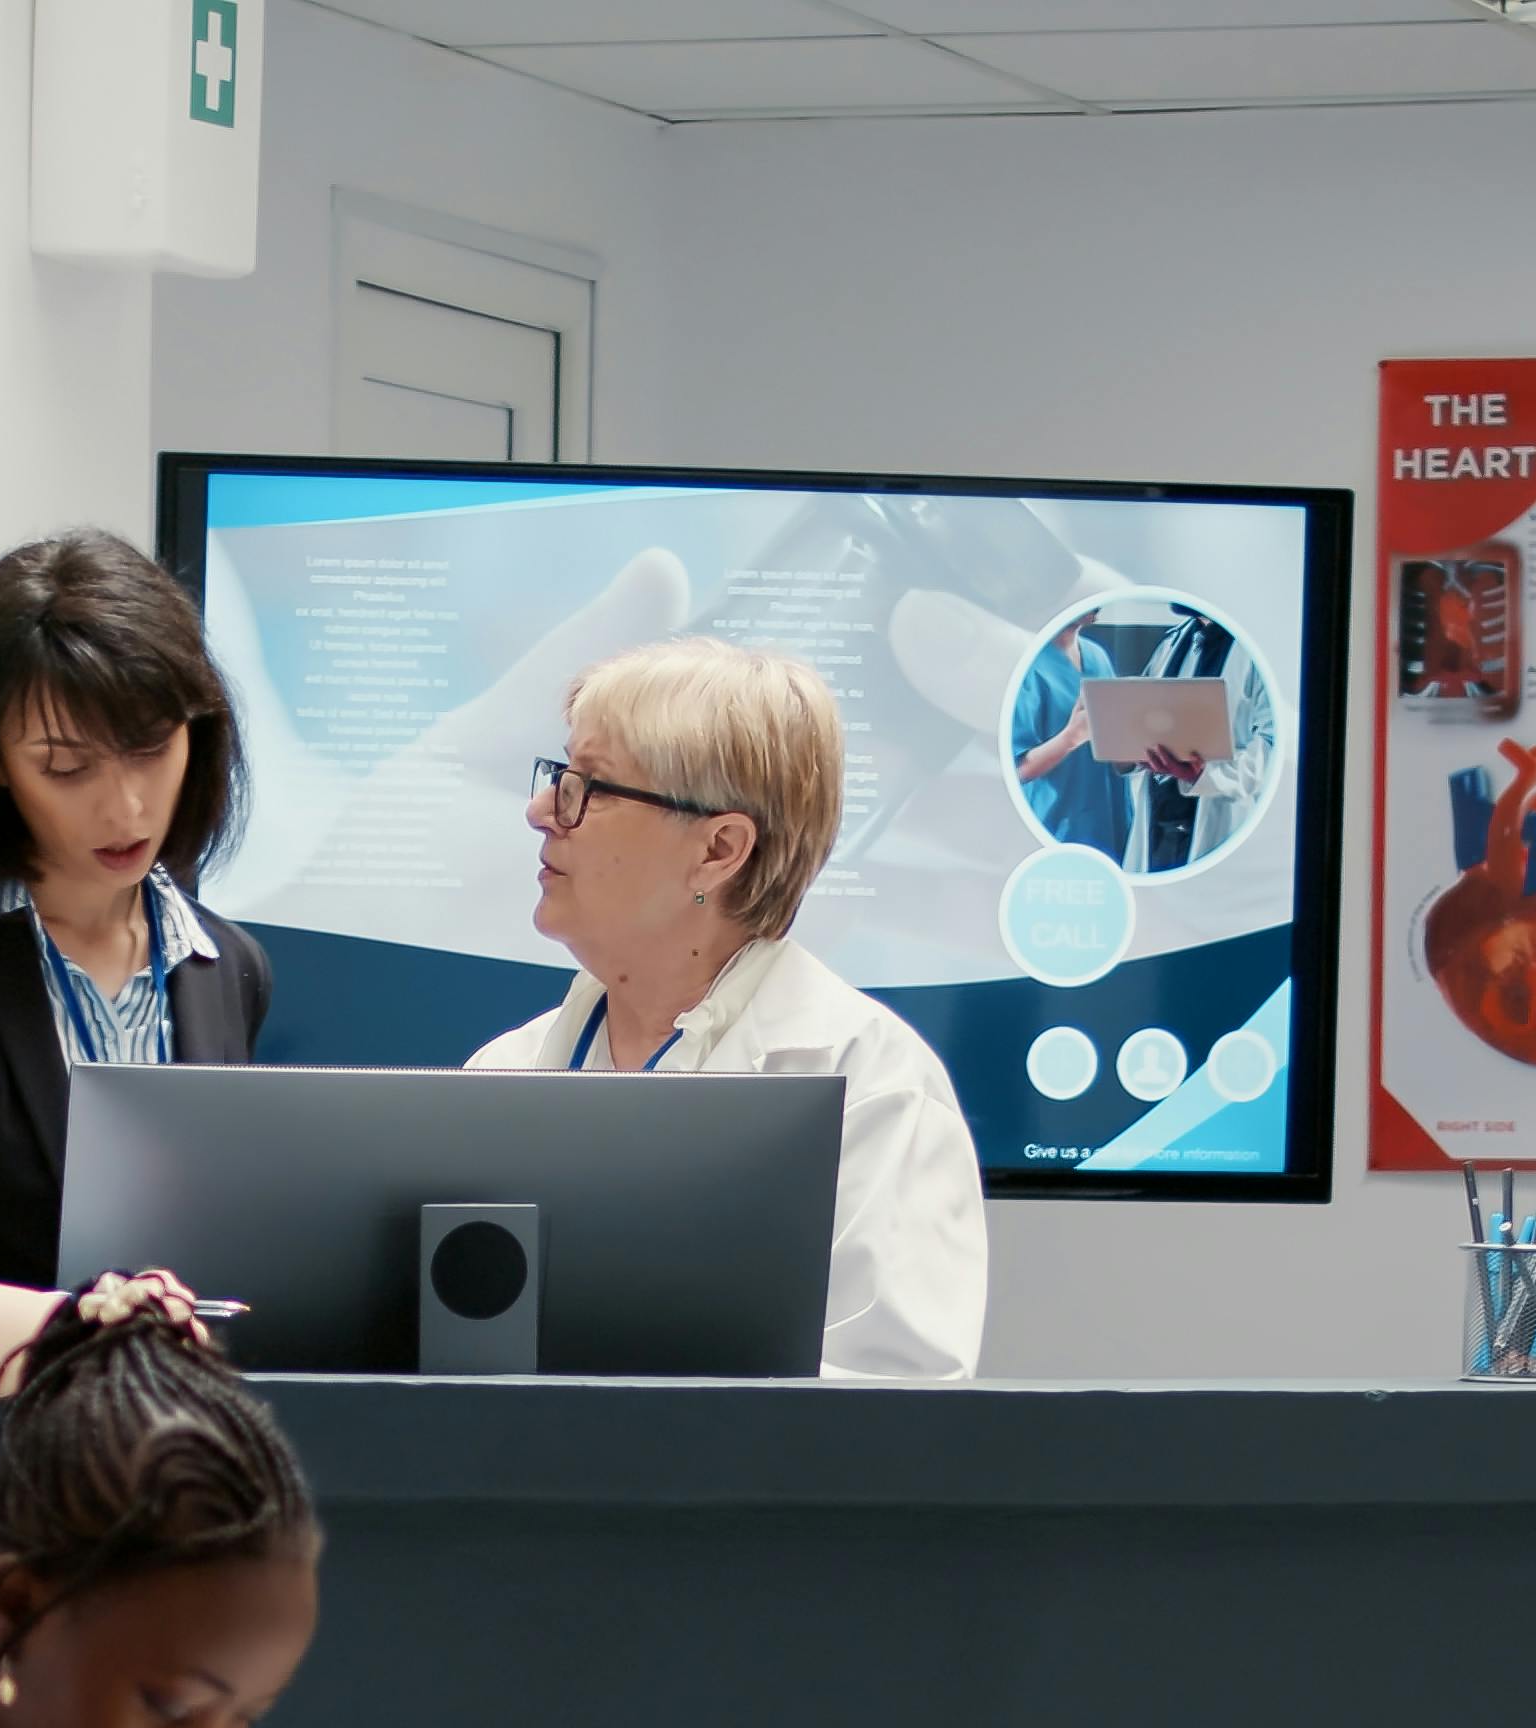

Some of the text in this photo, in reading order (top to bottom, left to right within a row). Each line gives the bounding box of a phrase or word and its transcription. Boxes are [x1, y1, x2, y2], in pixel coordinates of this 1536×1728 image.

[1423, 393, 1508, 427] THE
[1025, 879, 1105, 904] FREE
[1031, 921, 1107, 949] CALL
[1436, 1121, 1515, 1132] RIGHT SIDE
[1024, 1143, 1057, 1159] Give
[1060, 1149, 1078, 1159] us
[1080, 1149, 1090, 1159] a
[1183, 1147, 1260, 1161] information
